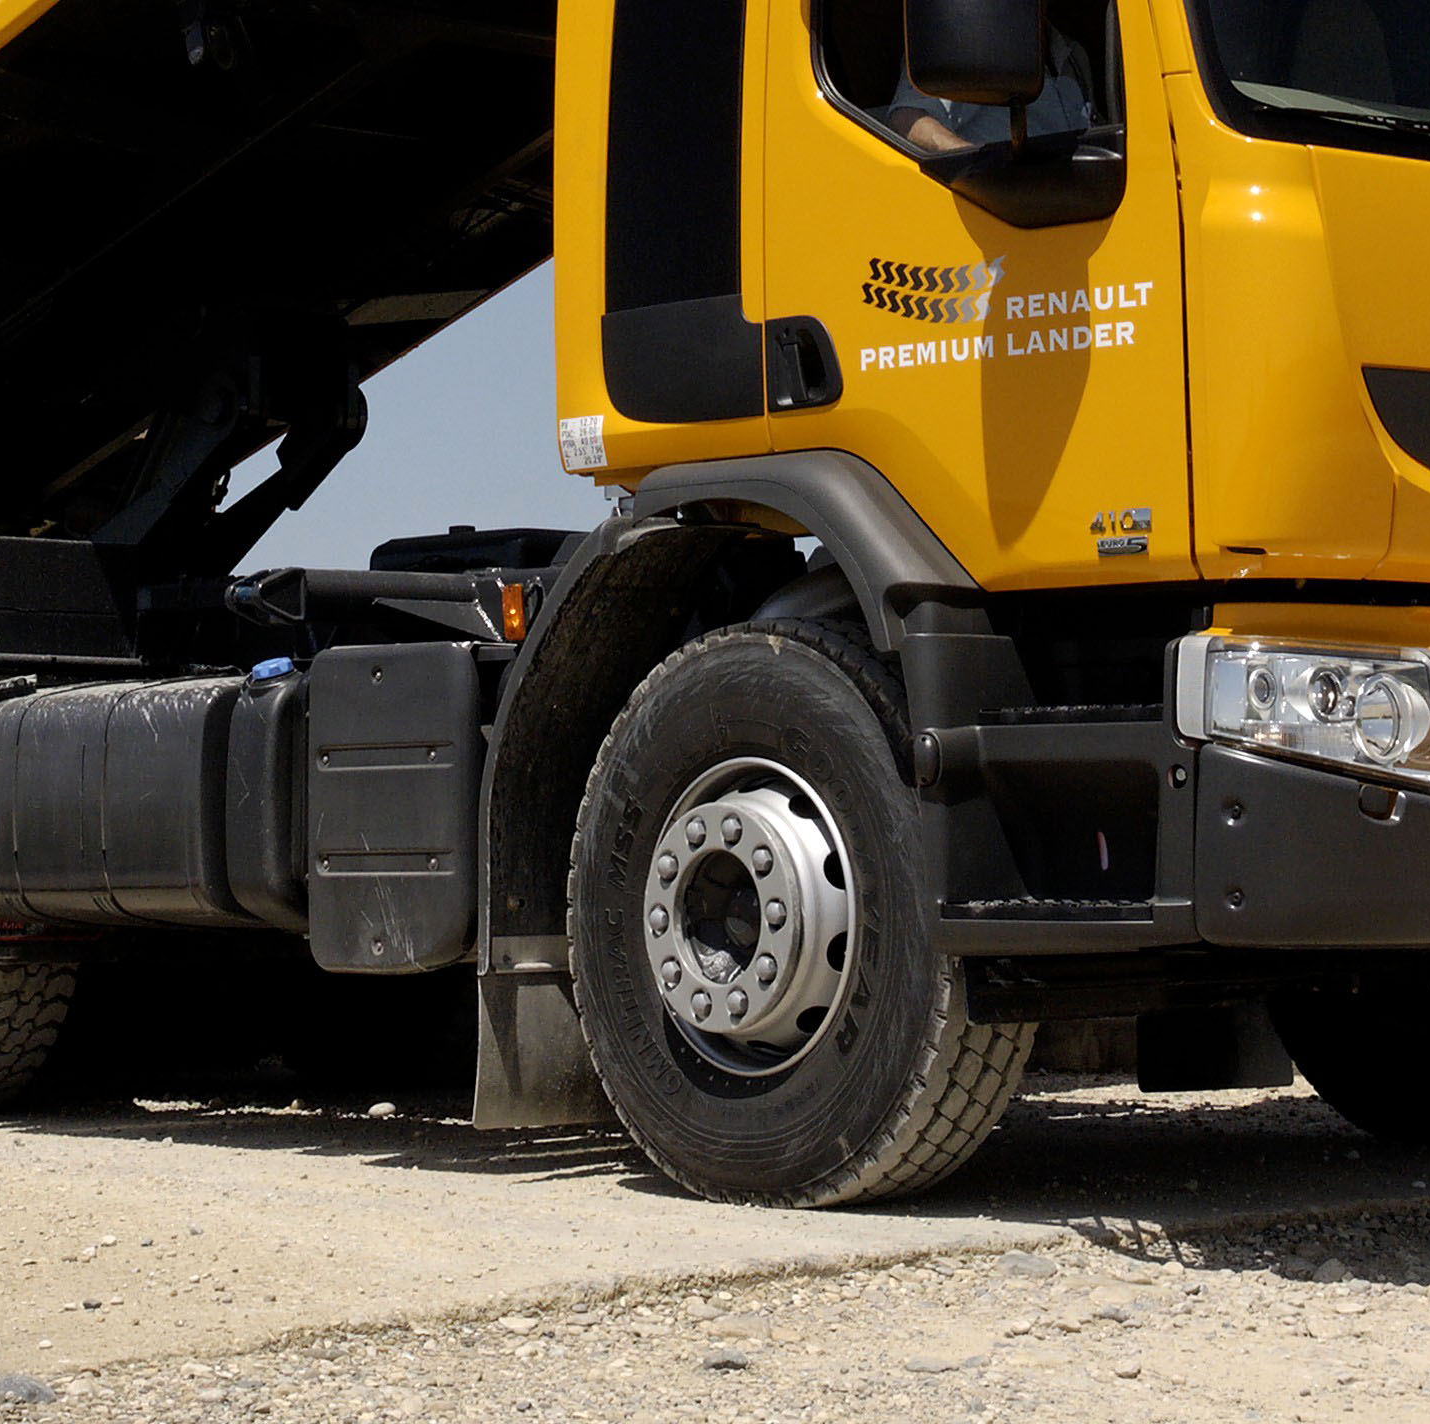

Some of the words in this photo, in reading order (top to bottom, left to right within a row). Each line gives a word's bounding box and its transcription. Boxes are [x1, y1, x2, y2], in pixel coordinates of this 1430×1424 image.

[1005, 281, 1154, 320] RENAULT
[859, 335, 995, 372] PREMIUM
[1006, 320, 1136, 357] LANDER
